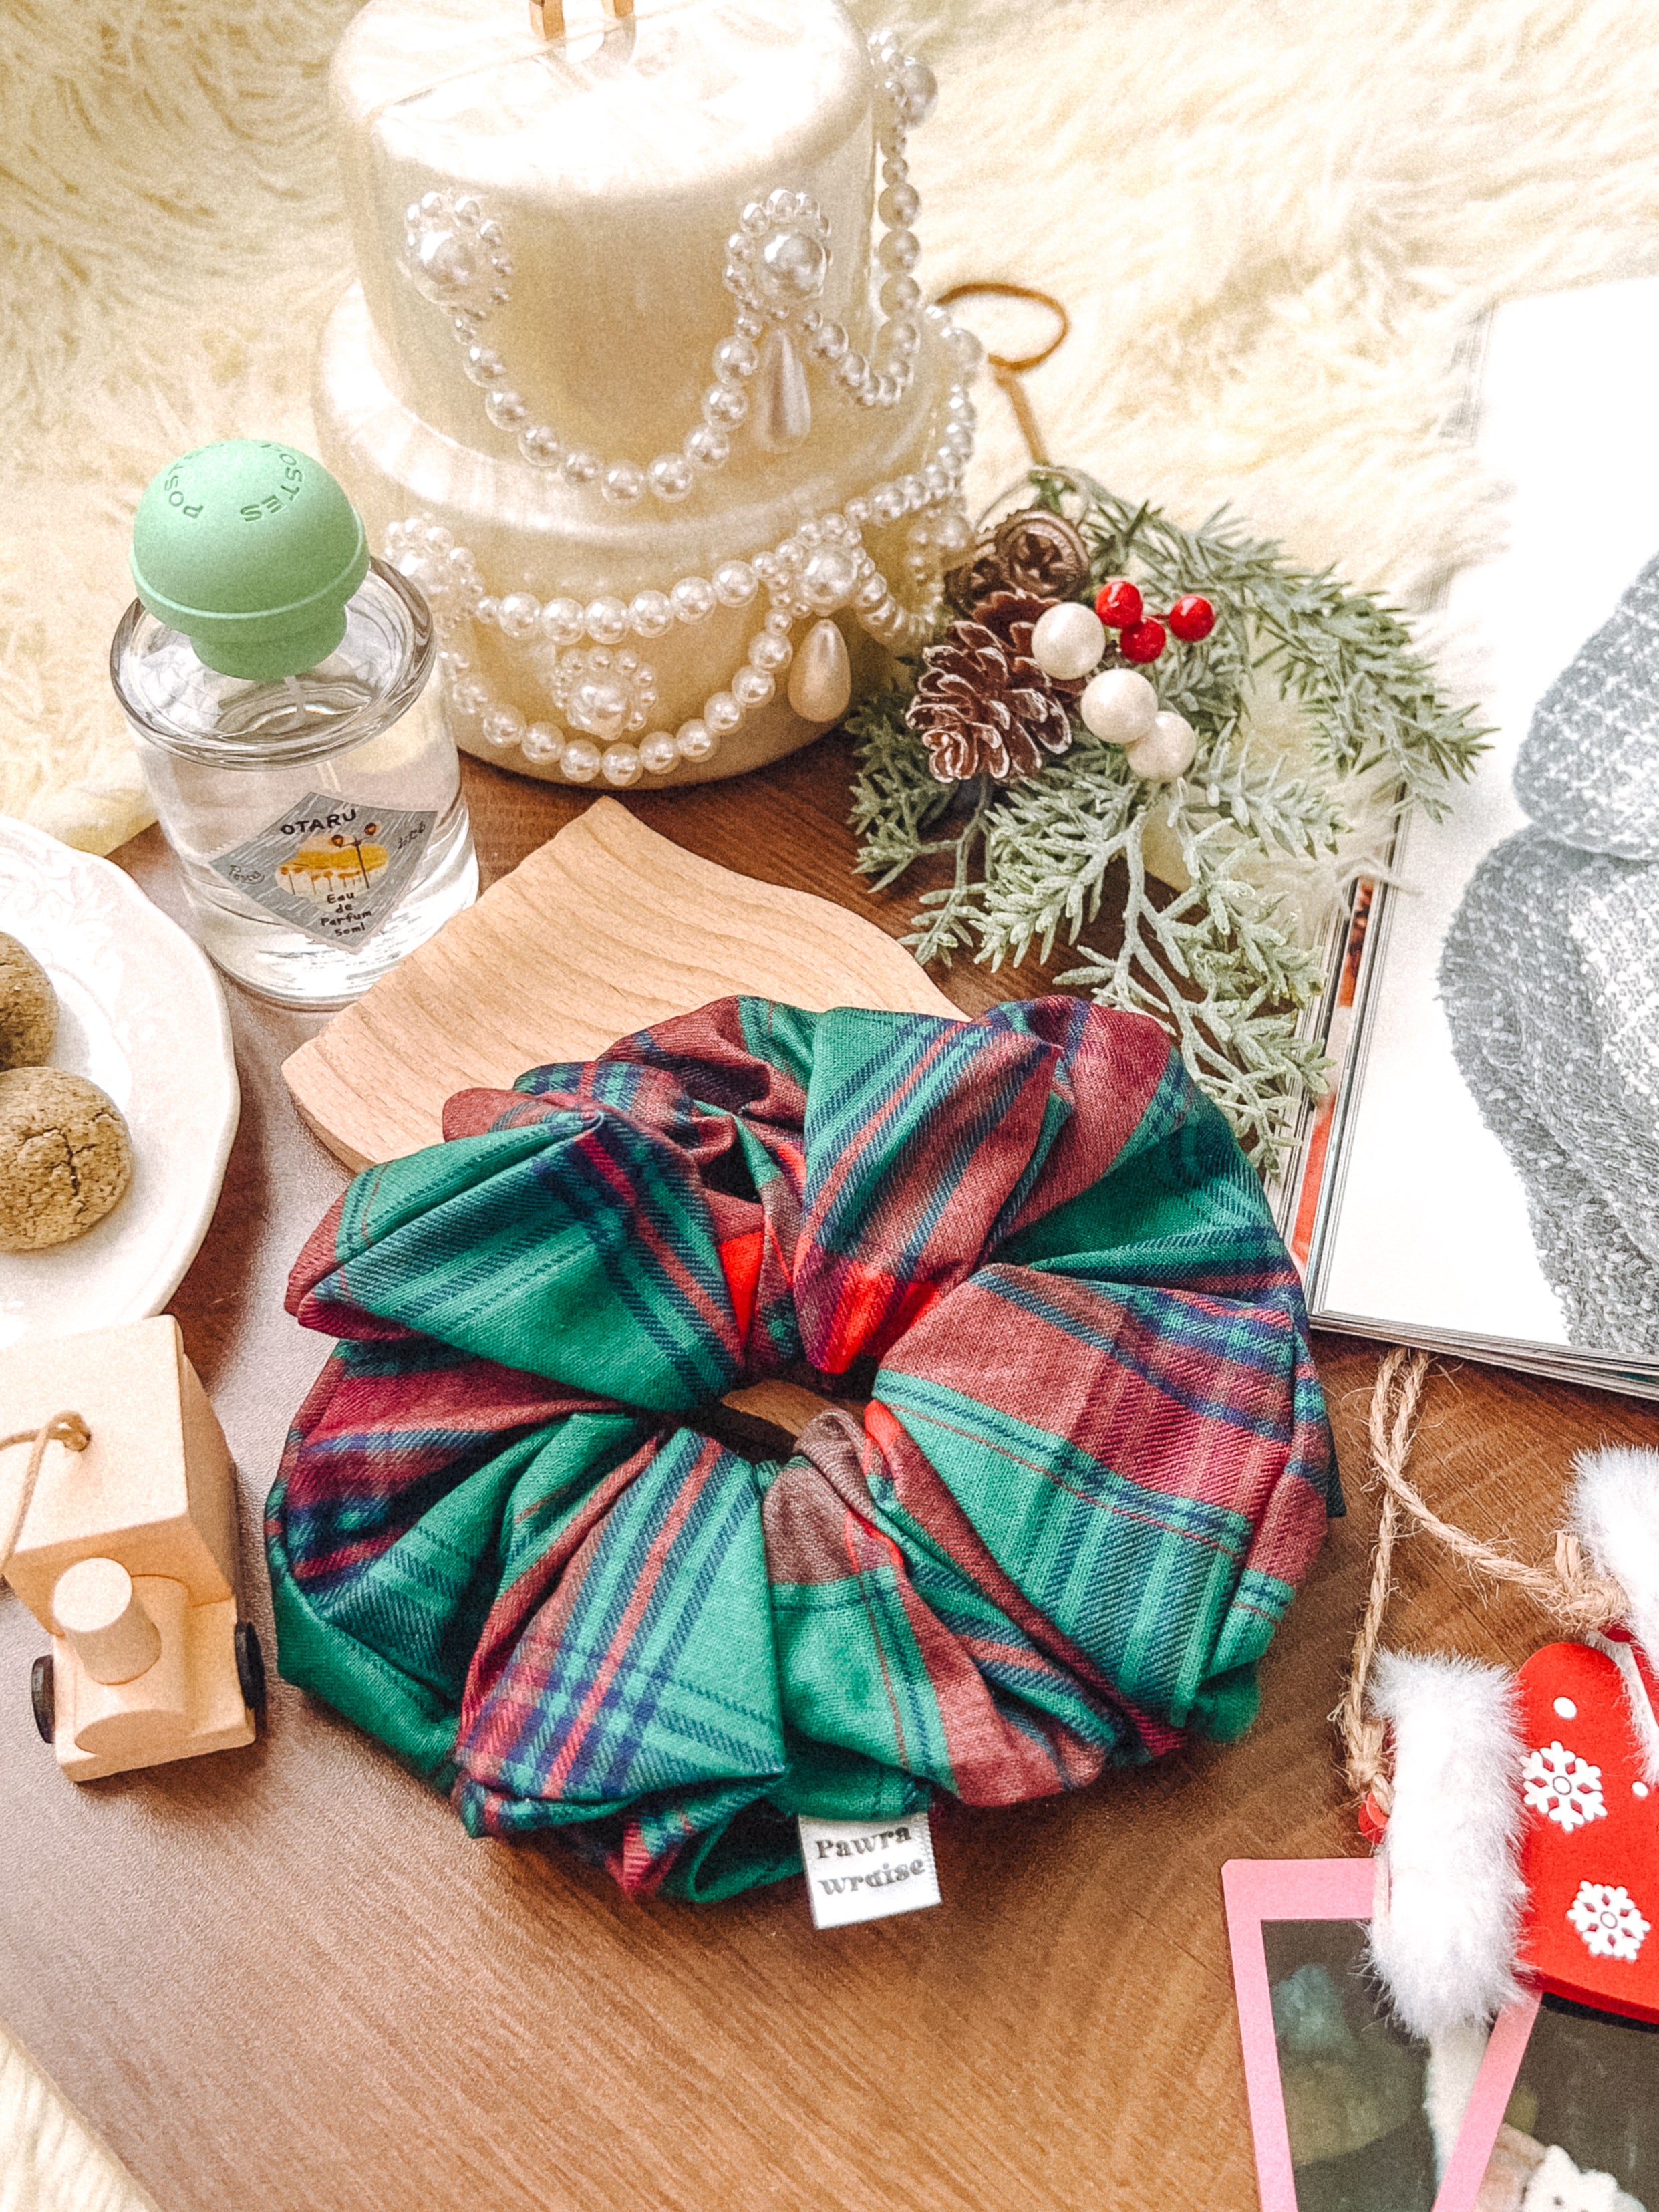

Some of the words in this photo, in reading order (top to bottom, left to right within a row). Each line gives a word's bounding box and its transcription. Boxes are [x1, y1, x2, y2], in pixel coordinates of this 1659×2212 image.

[281, 809, 357, 835] OTARU
[327, 892, 355, 905] Eau
[335, 903, 353, 914] de
[321, 910, 372, 927] Parfum
[815, 1826, 913, 1860] Pawra
